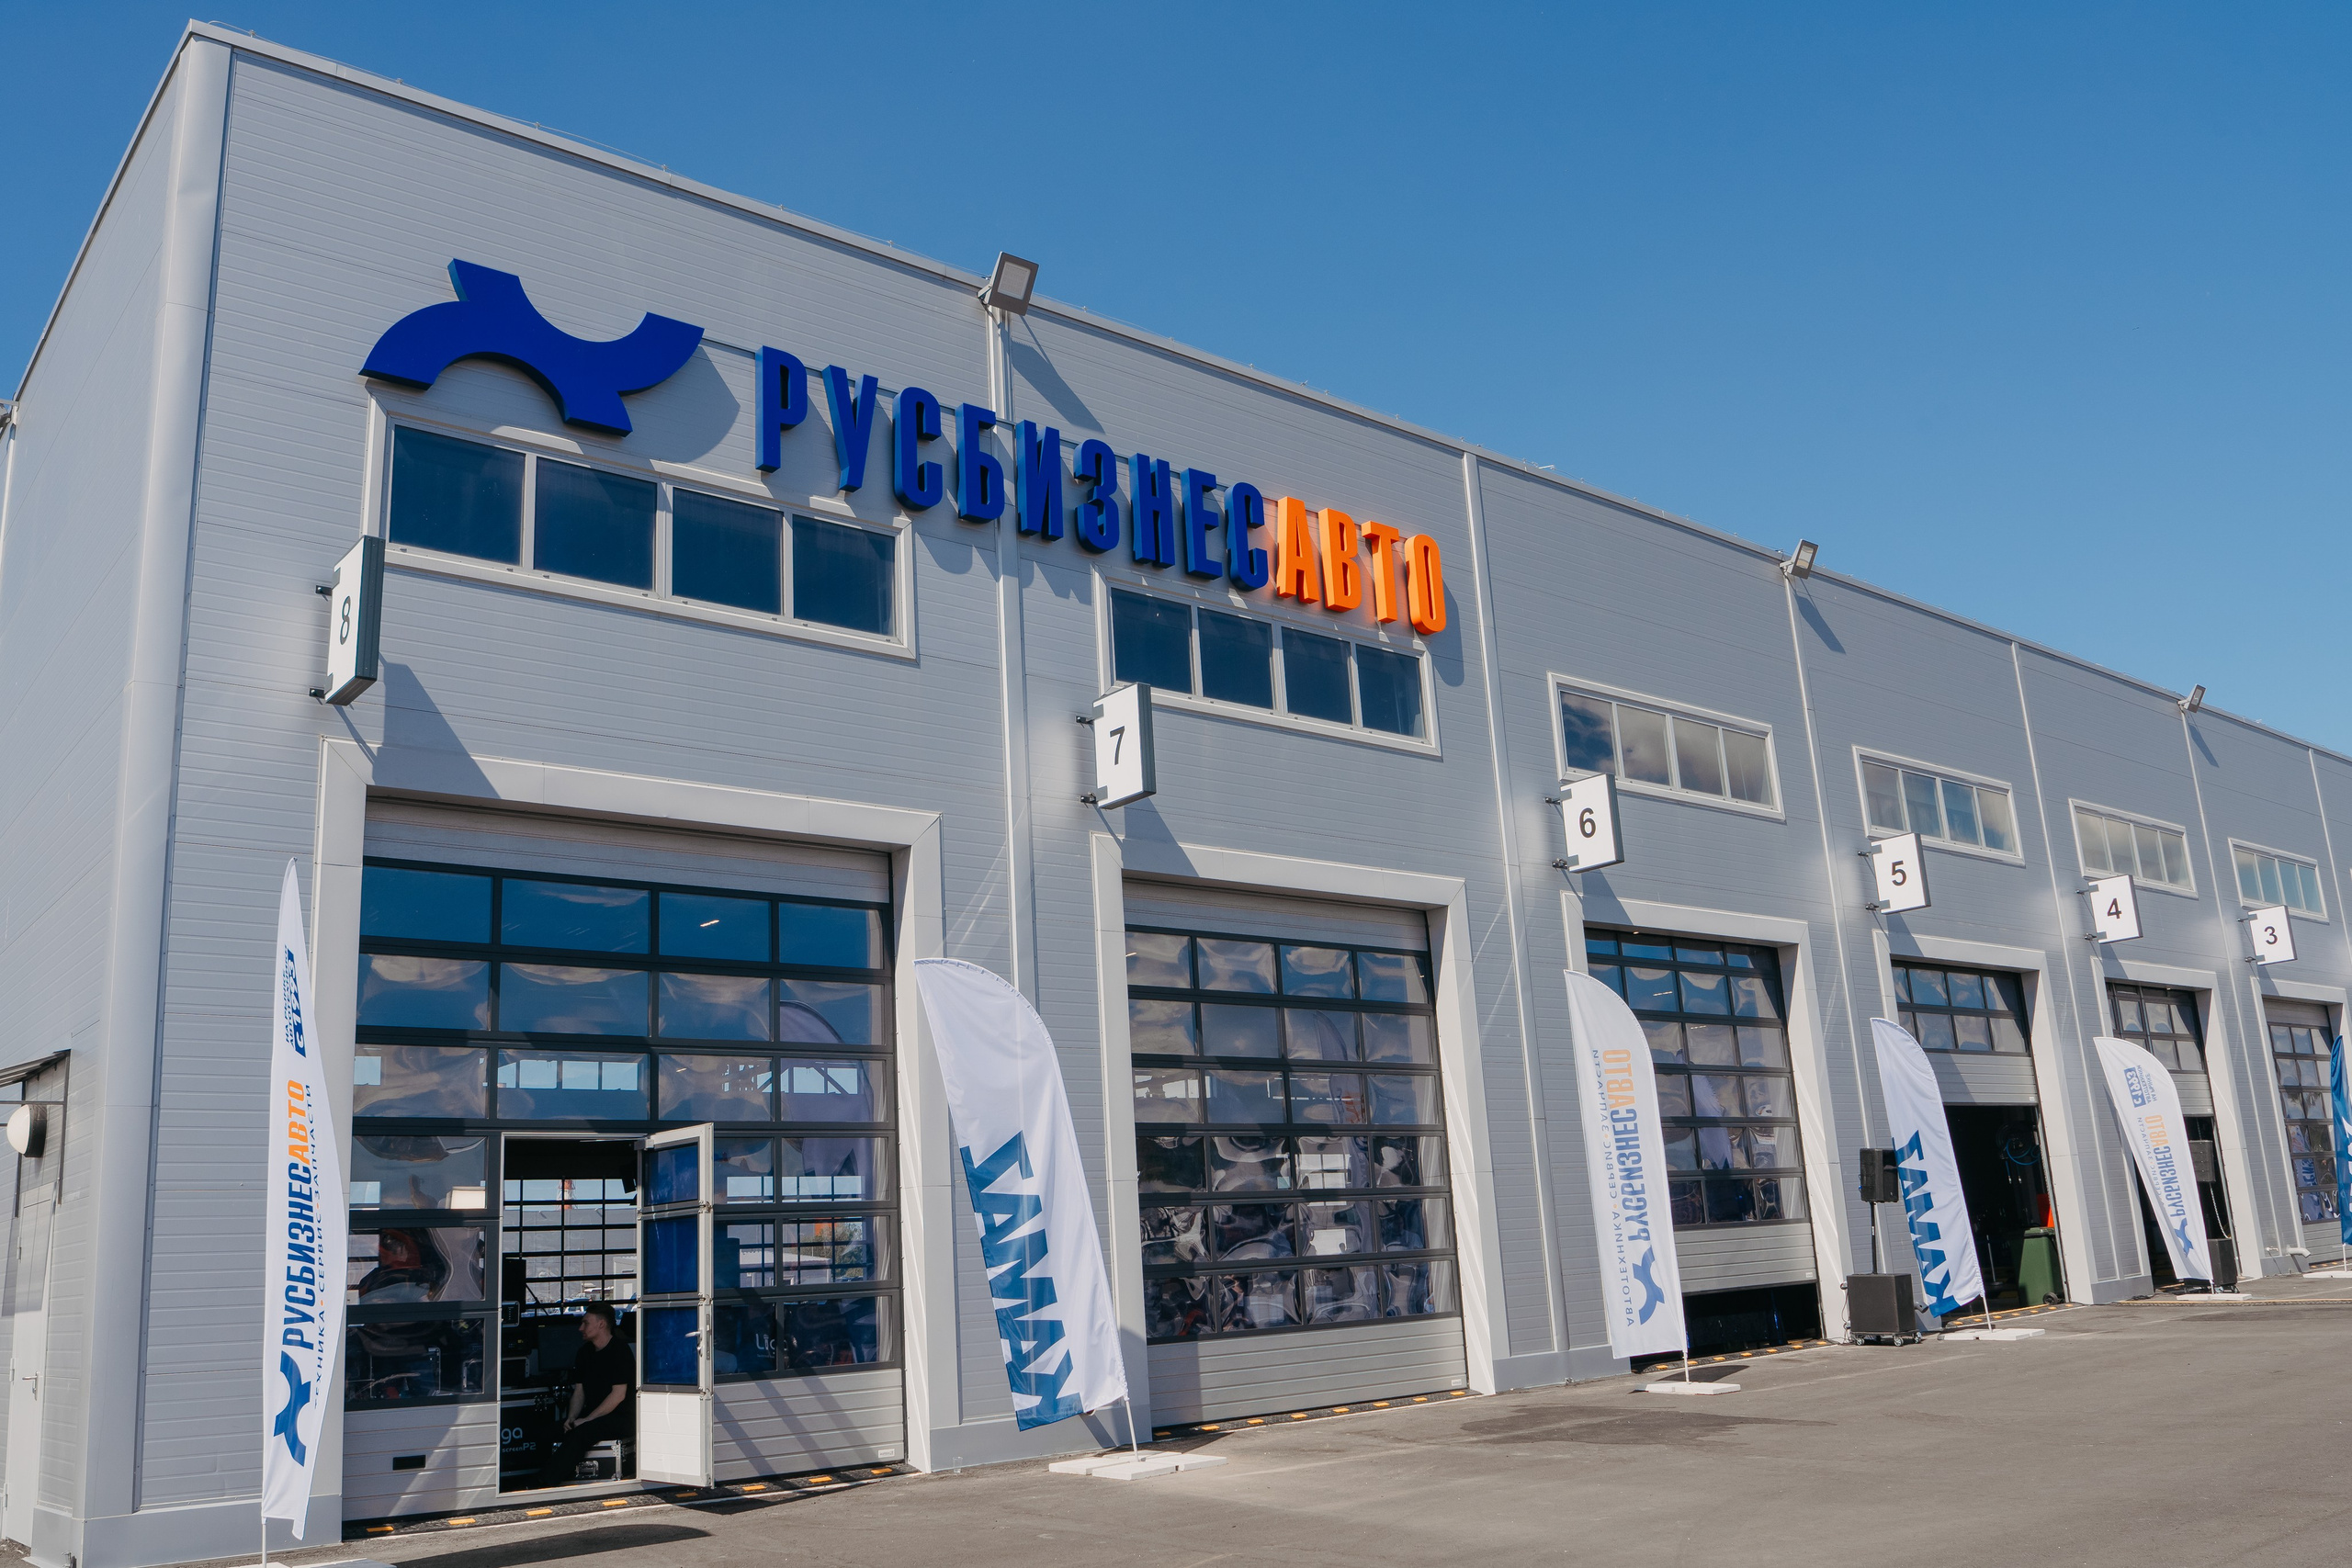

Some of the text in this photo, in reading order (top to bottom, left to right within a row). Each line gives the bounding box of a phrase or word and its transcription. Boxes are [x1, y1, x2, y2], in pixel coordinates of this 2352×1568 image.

[755, 345, 1447, 636] РУСБИЗНЕСАВТО
[340, 595, 351, 645] 8
[1110, 726, 1125, 765] 7
[1579, 807, 1597, 838] 6
[1892, 860, 1907, 886] 5
[2107, 897, 2122, 919] 4
[2264, 926, 2278, 945] 3
[288, 959, 301, 1026] 1993
[305, 1085, 321, 1200] ЗАПЧАСТИ
[282, 1079, 315, 1349] РУСБИЗНЕСАВТО
[316, 1213, 325, 1292] СЕРВИС
[501, 1427, 523, 1444] ga
